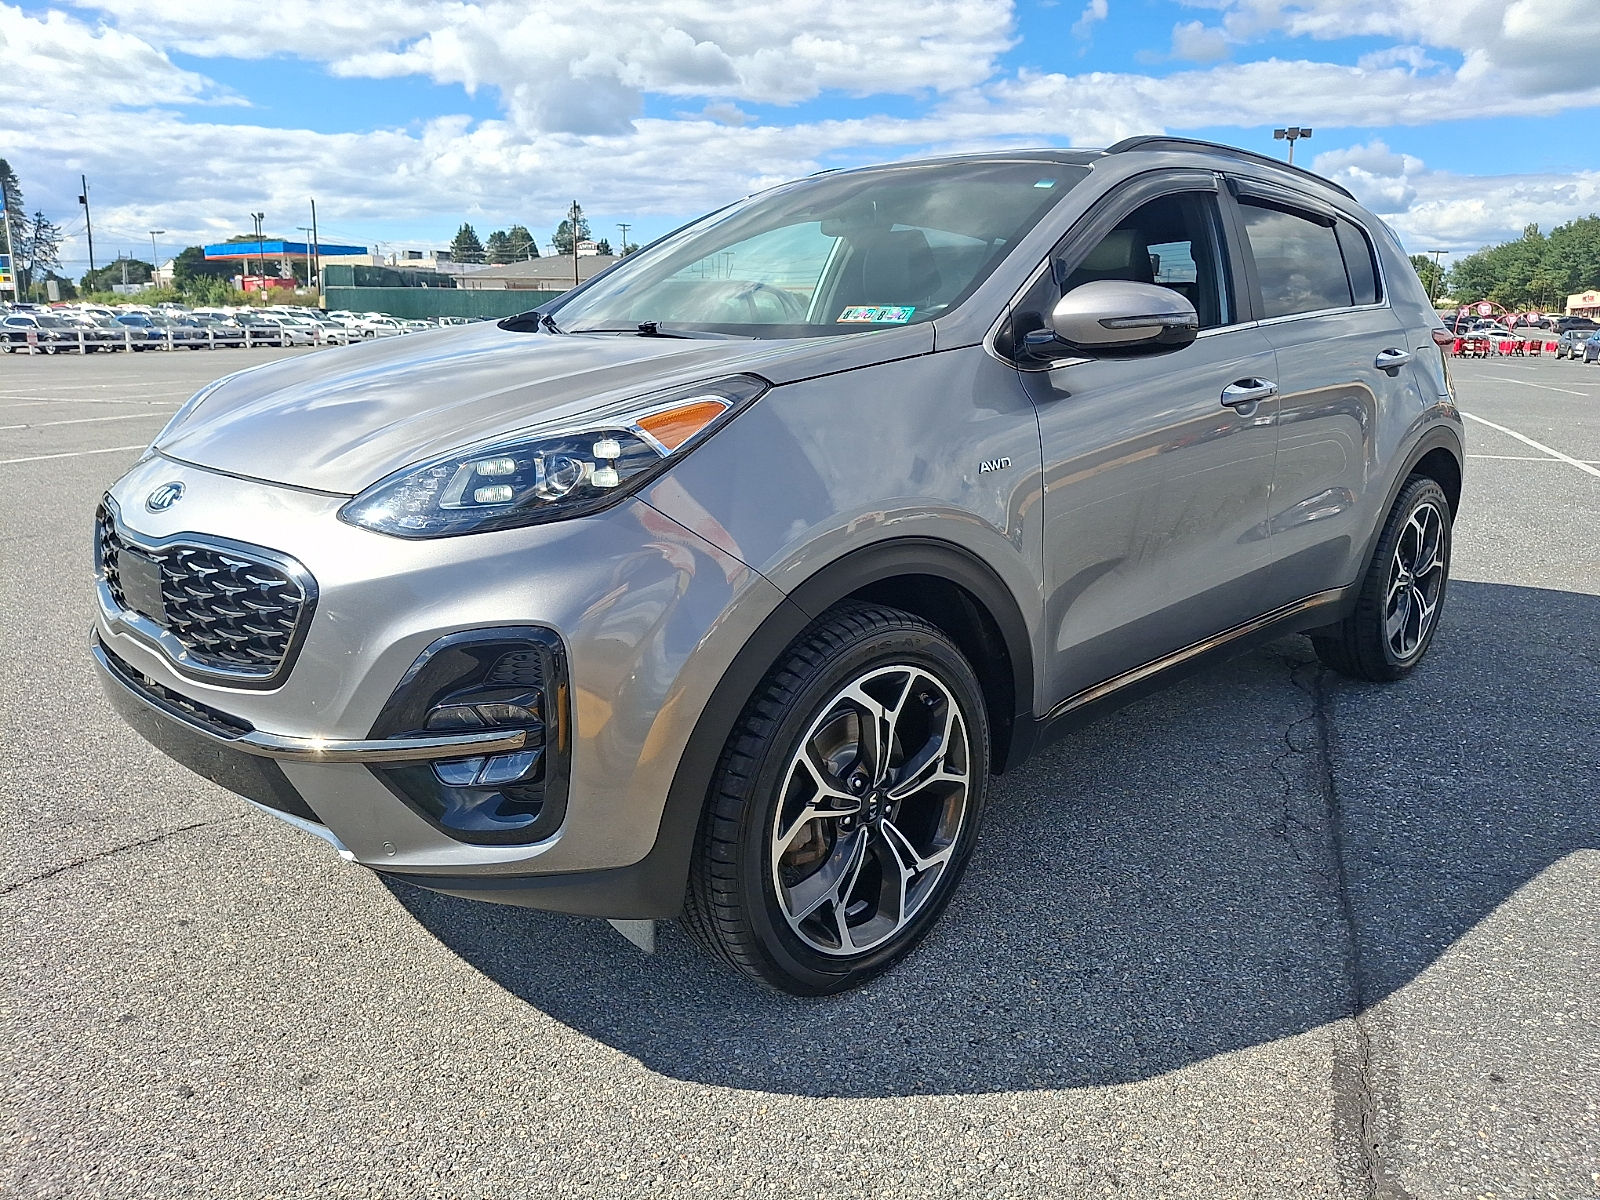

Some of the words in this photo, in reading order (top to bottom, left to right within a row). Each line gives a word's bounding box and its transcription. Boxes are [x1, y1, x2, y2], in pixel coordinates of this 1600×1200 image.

[843, 310, 852, 320] 8
[877, 310, 886, 321] 8
[979, 456, 1012, 474] AWD
[869, 792, 878, 821] KIA
